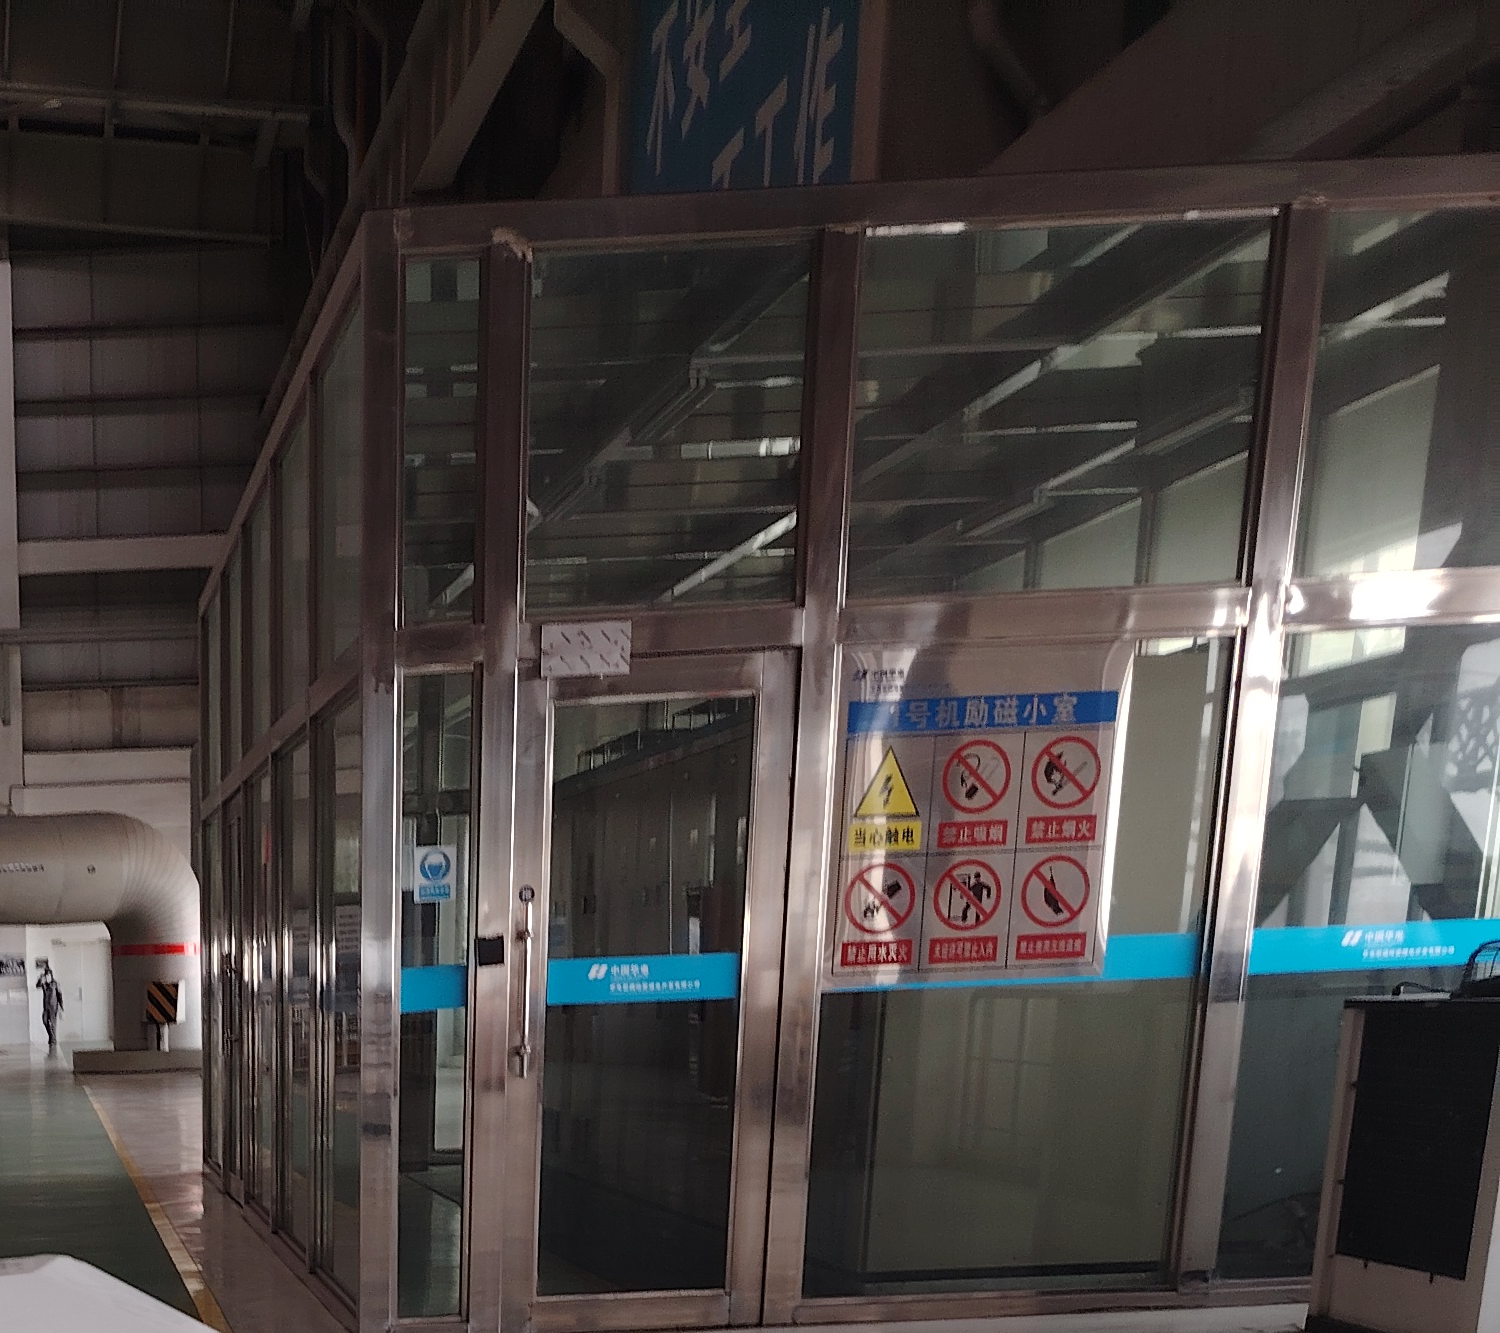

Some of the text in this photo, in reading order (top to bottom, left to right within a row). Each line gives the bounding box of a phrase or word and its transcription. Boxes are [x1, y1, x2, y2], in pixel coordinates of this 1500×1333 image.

[853, 825, 915, 847] 当心触电
[942, 825, 1003, 843] 禁止吸烟
[1031, 819, 1090, 839] 禁止烟火
